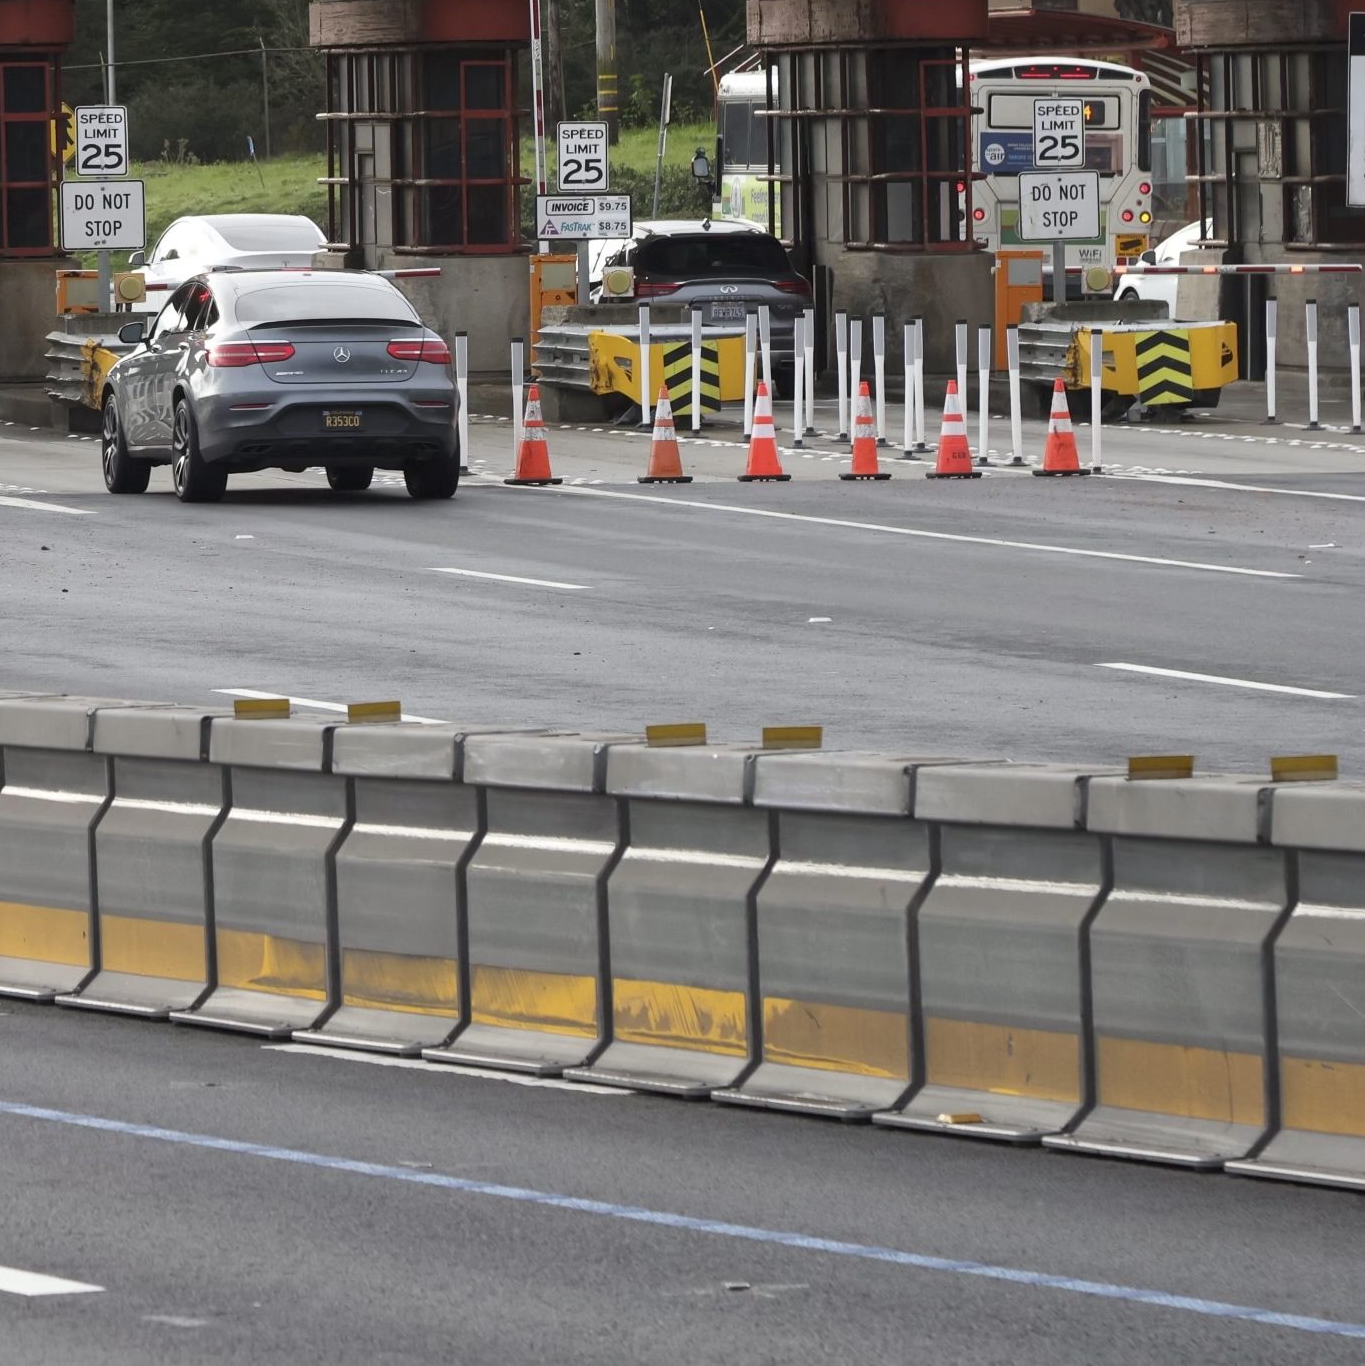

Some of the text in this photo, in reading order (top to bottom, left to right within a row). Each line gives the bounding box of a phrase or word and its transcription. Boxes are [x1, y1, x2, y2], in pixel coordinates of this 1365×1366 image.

[1037, 105, 1080, 116] SPEED
[80, 113, 123, 124] SPEED
[1041, 120, 1076, 131] LIMIT
[84, 128, 119, 139] LIMIT
[562, 129, 604, 139] SPEED
[566, 144, 600, 154] LIMIT
[1038, 135, 1080, 161] 25
[81, 143, 124, 170] 25
[562, 158, 604, 184] 25
[1032, 184, 1086, 201] DO NOT
[74, 193, 131, 211] DO NOT
[551, 202, 627, 212] INVOICE $9.75
[1042, 211, 1078, 227] STOP
[85, 220, 122, 237] STOP
[598, 221, 627, 231] $8.75
[1079, 249, 1102, 258] WiFi
